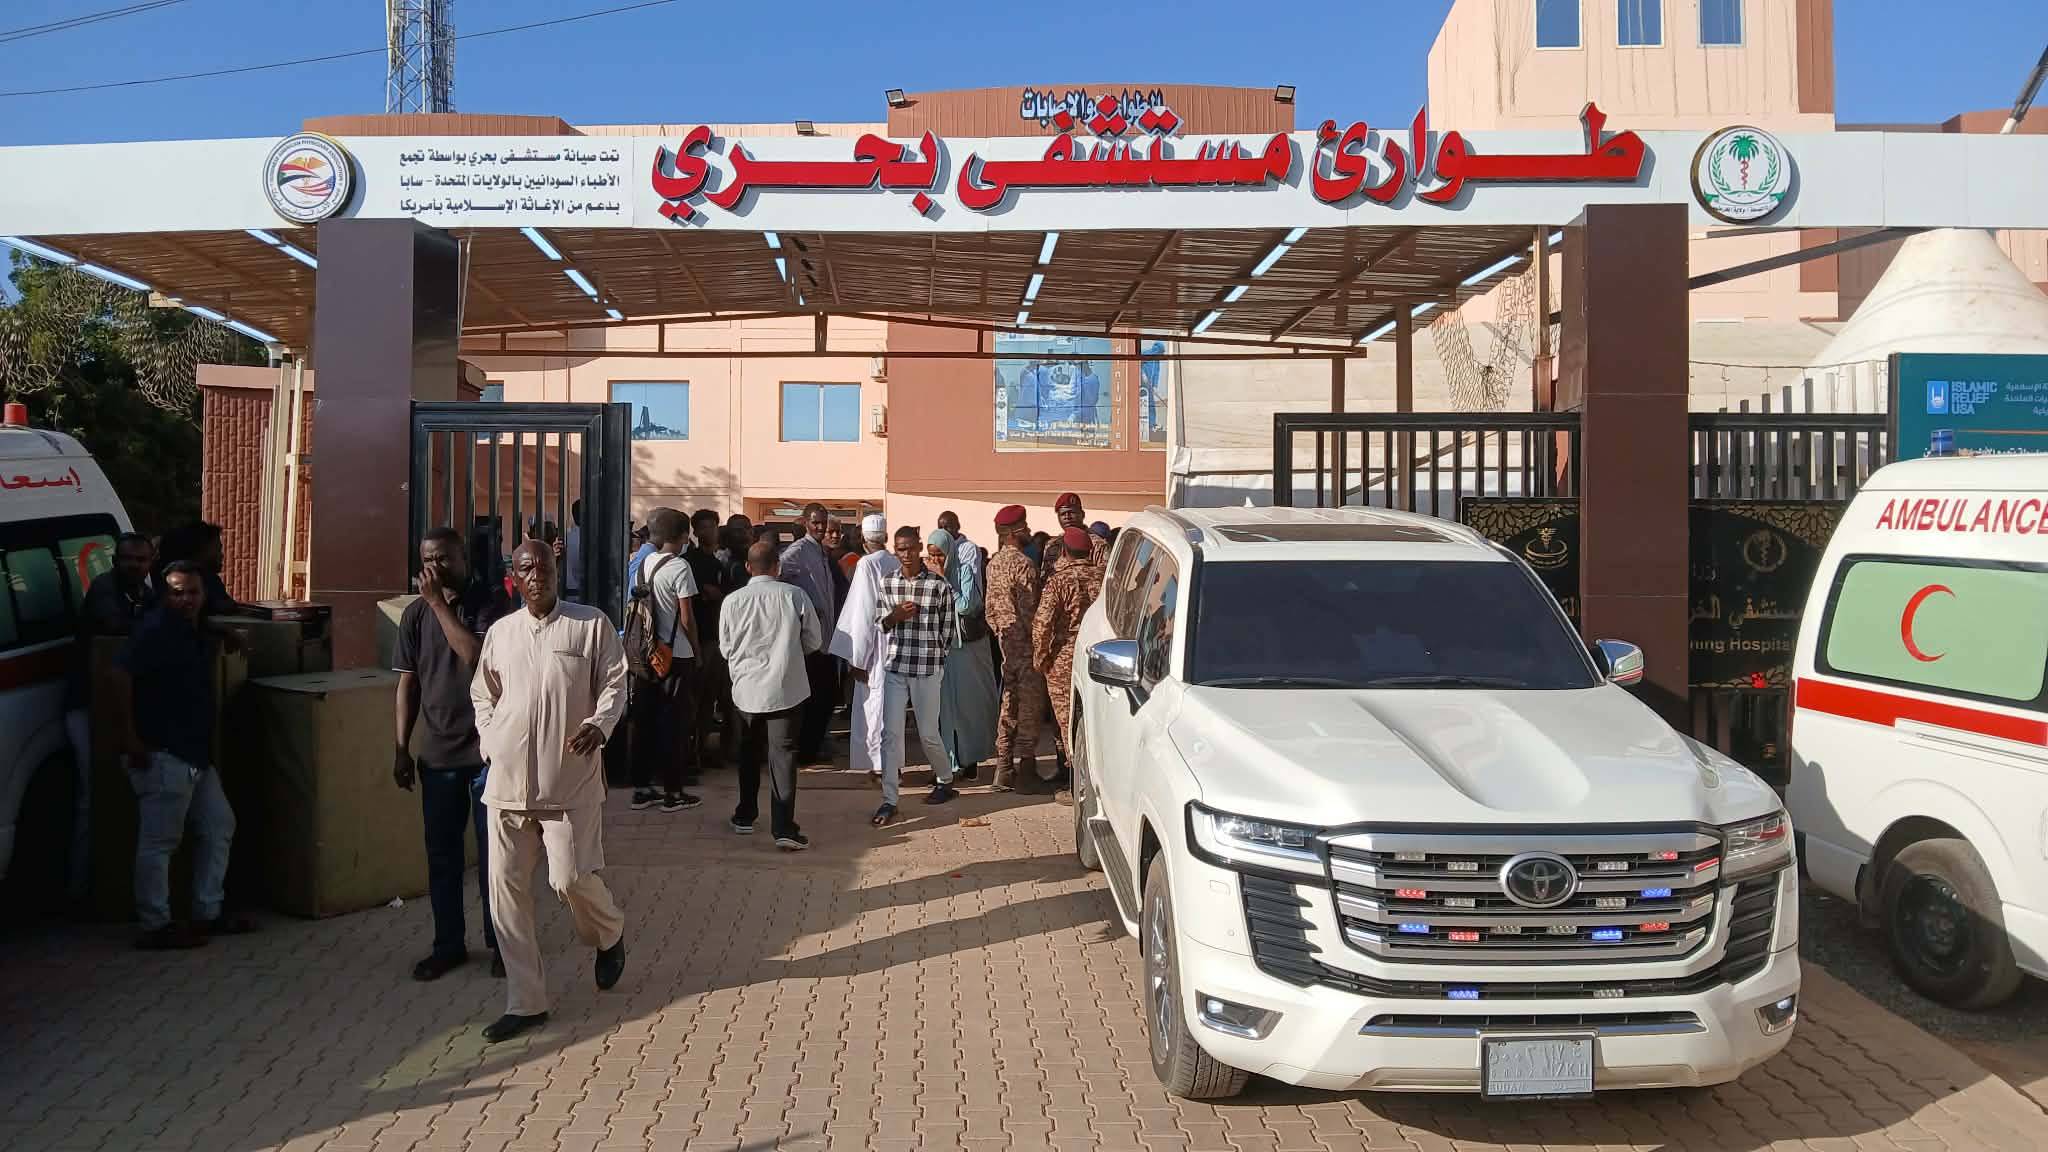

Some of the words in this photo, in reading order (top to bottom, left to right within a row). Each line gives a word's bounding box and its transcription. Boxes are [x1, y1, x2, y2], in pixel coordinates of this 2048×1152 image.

[399, 149, 425, 167] تجمع
[427, 148, 467, 165] بواسطة
[468, 151, 498, 166] بحري
[499, 148, 561, 165] مستشفى
[563, 148, 597, 165] صيانة
[599, 148, 620, 162] تمت
[956, 94, 1294, 211] مستشفى
[1309, 102, 1647, 204] طوارئ
[400, 175, 423, 191] سابا
[434, 174, 470, 187] المتحدة
[472, 173, 522, 191] بالولايات
[523, 174, 578, 191] السودانيين
[651, 124, 942, 227] بحري
[567, 199, 583, 215] من
[585, 200, 620, 216] بدعم
[1951, 381, 1998, 393] ISLAMIC
[1951, 392, 1990, 404] RELIEF
[1951, 403, 1975, 415] USA
[0, 466, 83, 494] إسعا
[1875, 498, 2048, 536] AMBULANCE
[1729, 638, 1793, 655] Hospita
